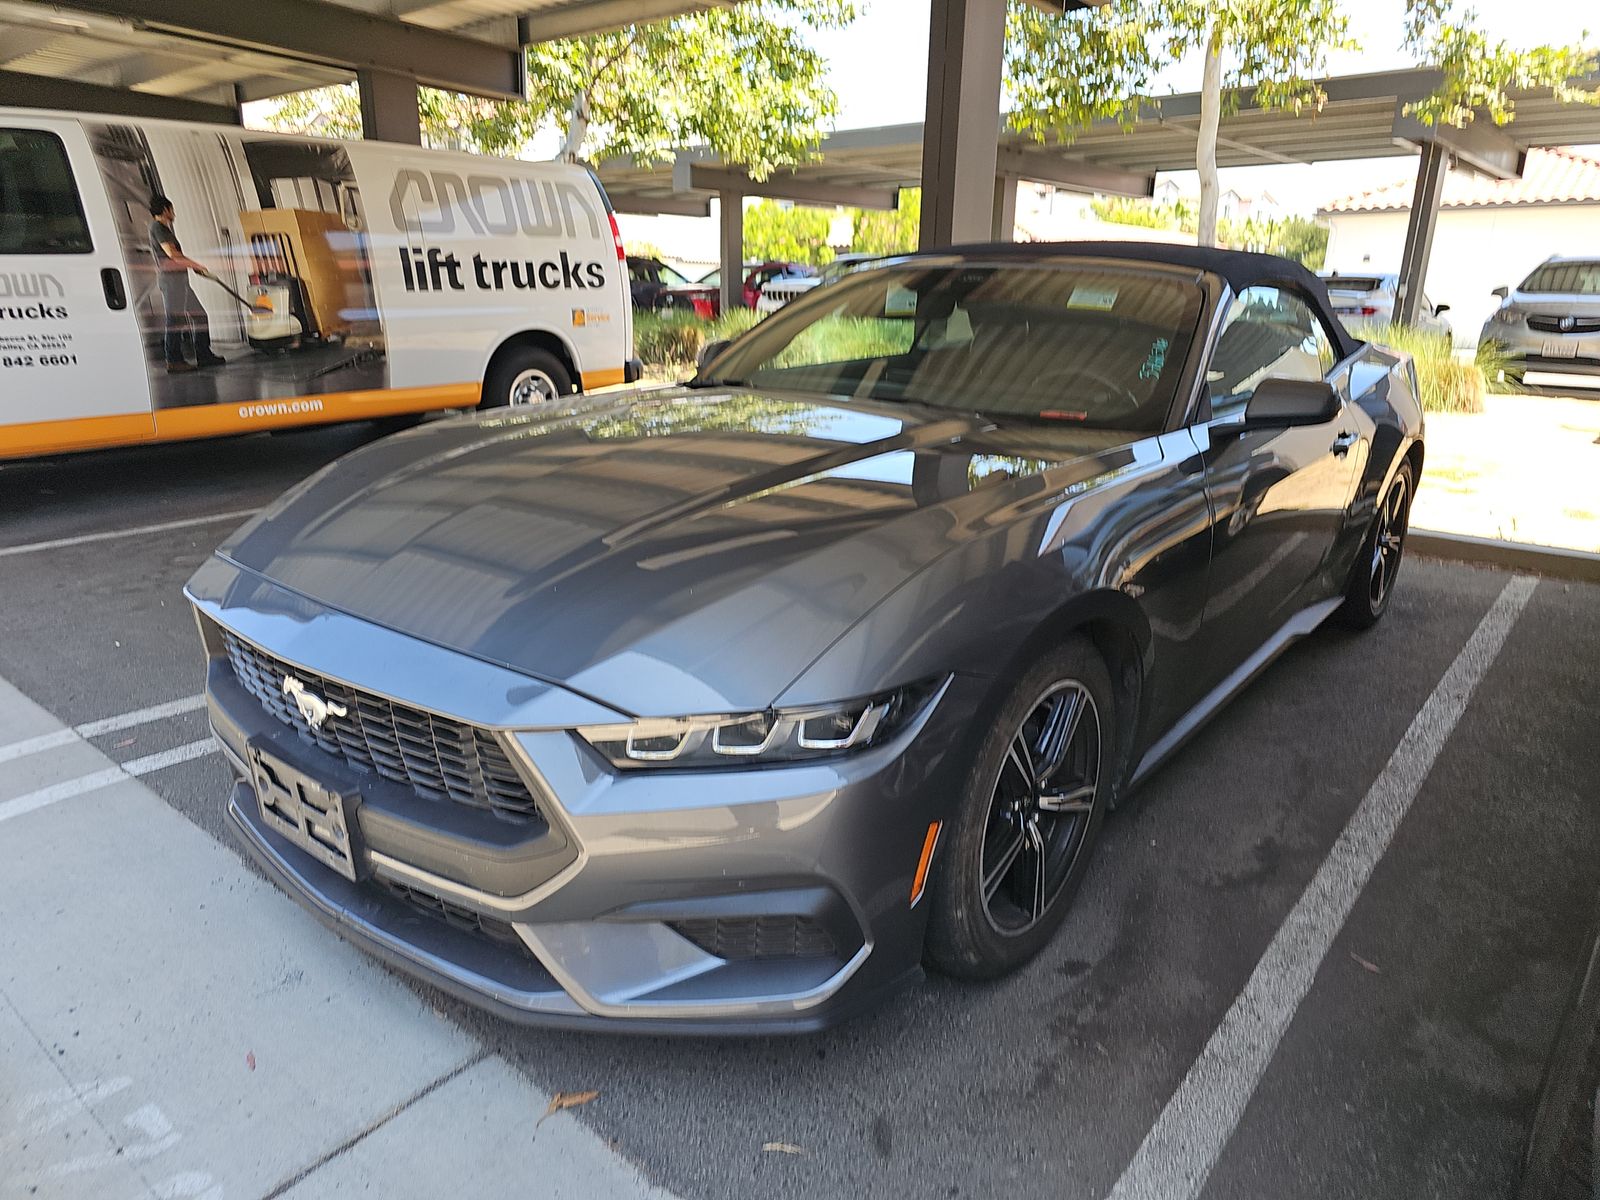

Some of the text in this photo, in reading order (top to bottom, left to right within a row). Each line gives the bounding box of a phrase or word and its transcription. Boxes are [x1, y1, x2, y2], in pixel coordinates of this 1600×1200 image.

[398, 246, 605, 292] lift trucks
[0, 302, 68, 319] rucks
[39, 354, 78, 366] 6601
[238, 399, 324, 419] crown.com
